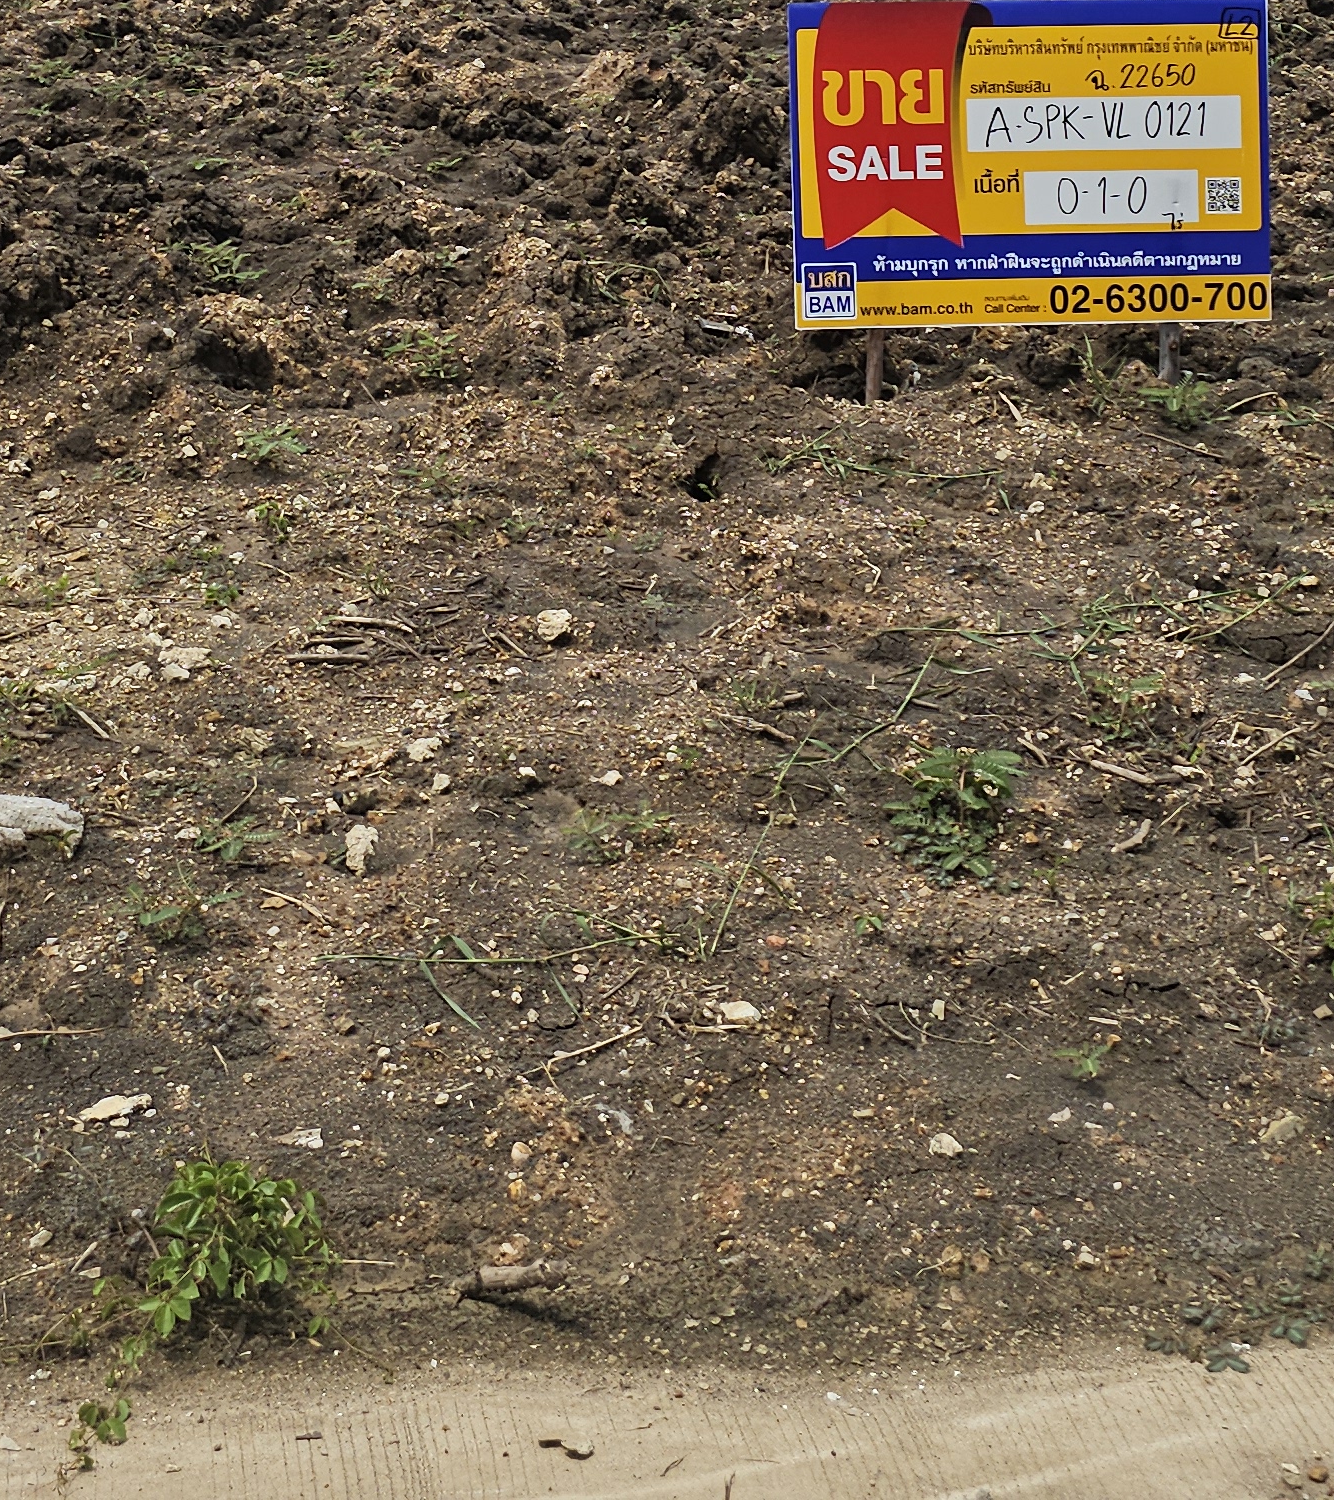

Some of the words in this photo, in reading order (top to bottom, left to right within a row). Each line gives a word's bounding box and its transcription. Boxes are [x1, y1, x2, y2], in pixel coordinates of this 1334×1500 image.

[968, 36, 1085, 57] บริษัทบริหารสินทรัพย์
[1087, 35, 1171, 60] กรุงเทพพาณิชย์
[1172, 36, 1204, 54] จำกัด
[1206, 39, 1254, 57] (มหาชน)
[822, 69, 945, 126] ขาย
[970, 79, 1051, 95] รหัสทรัพย์สิน
[1144, 100, 1207, 139] 0121
[827, 145, 944, 182] SALE
[973, 168, 1020, 194] เนื้อที่
[1057, 176, 1148, 215] 0-1-0
[872, 254, 949, 278] ห้ามบุกรุก
[954, 250, 1243, 276] หากฝ่าฝืนจะถูกดำเนินคดีตามกฎหมาย
[807, 269, 852, 290] บสก
[809, 295, 852, 315] BAM
[859, 302, 974, 318] www.bam.co.th
[984, 303, 1004, 314] Call
[1049, 281, 1268, 315] 02-6300-700
